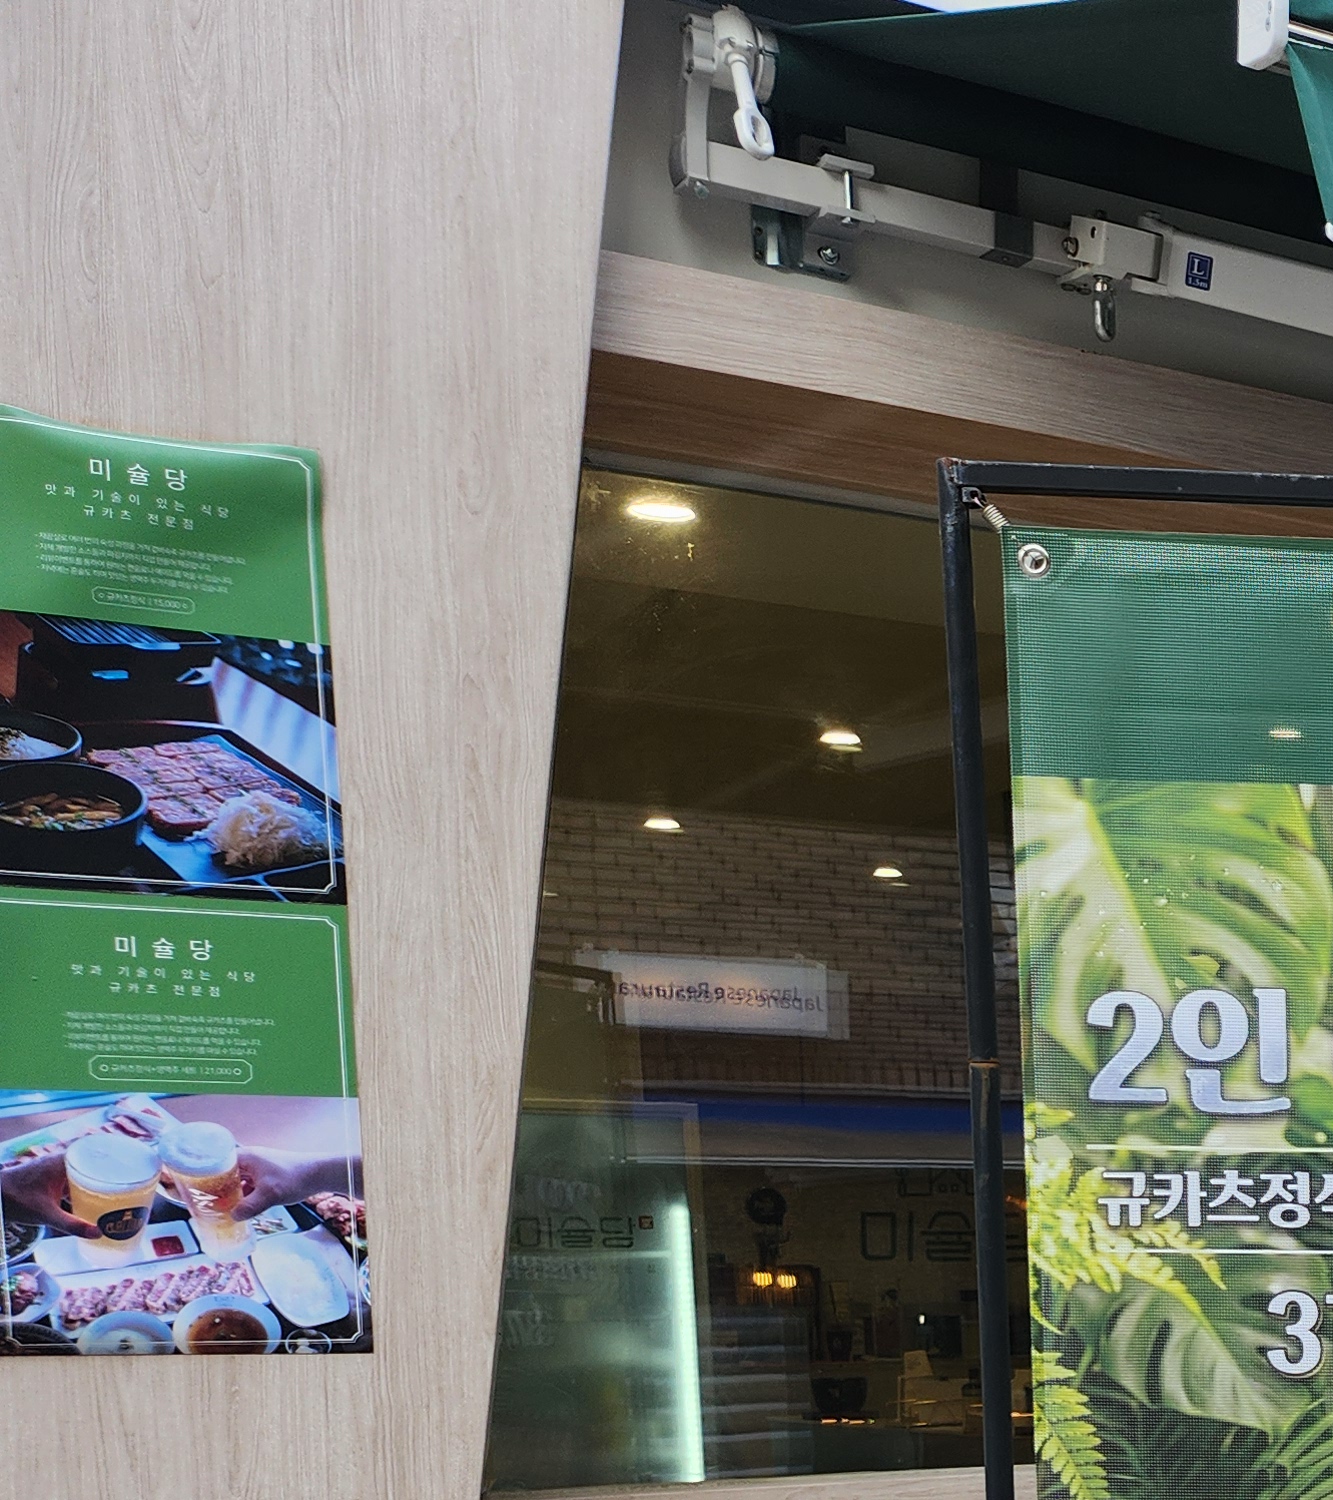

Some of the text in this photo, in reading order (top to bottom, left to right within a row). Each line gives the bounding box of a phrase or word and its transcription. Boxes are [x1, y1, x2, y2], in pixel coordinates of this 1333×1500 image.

[1191, 258, 1205, 276] L
[89, 458, 188, 491] 미슐당
[45, 483, 76, 498] 맛과
[156, 497, 186, 513] 있는
[200, 504, 229, 519] 식당
[83, 505, 194, 530] 규카츠 전문점
[113, 935, 214, 961] 미슐당
[226, 970, 256, 983] 식당
[109, 981, 220, 998] 규카츠 전문점
[1086, 987, 1292, 1114] 2인
